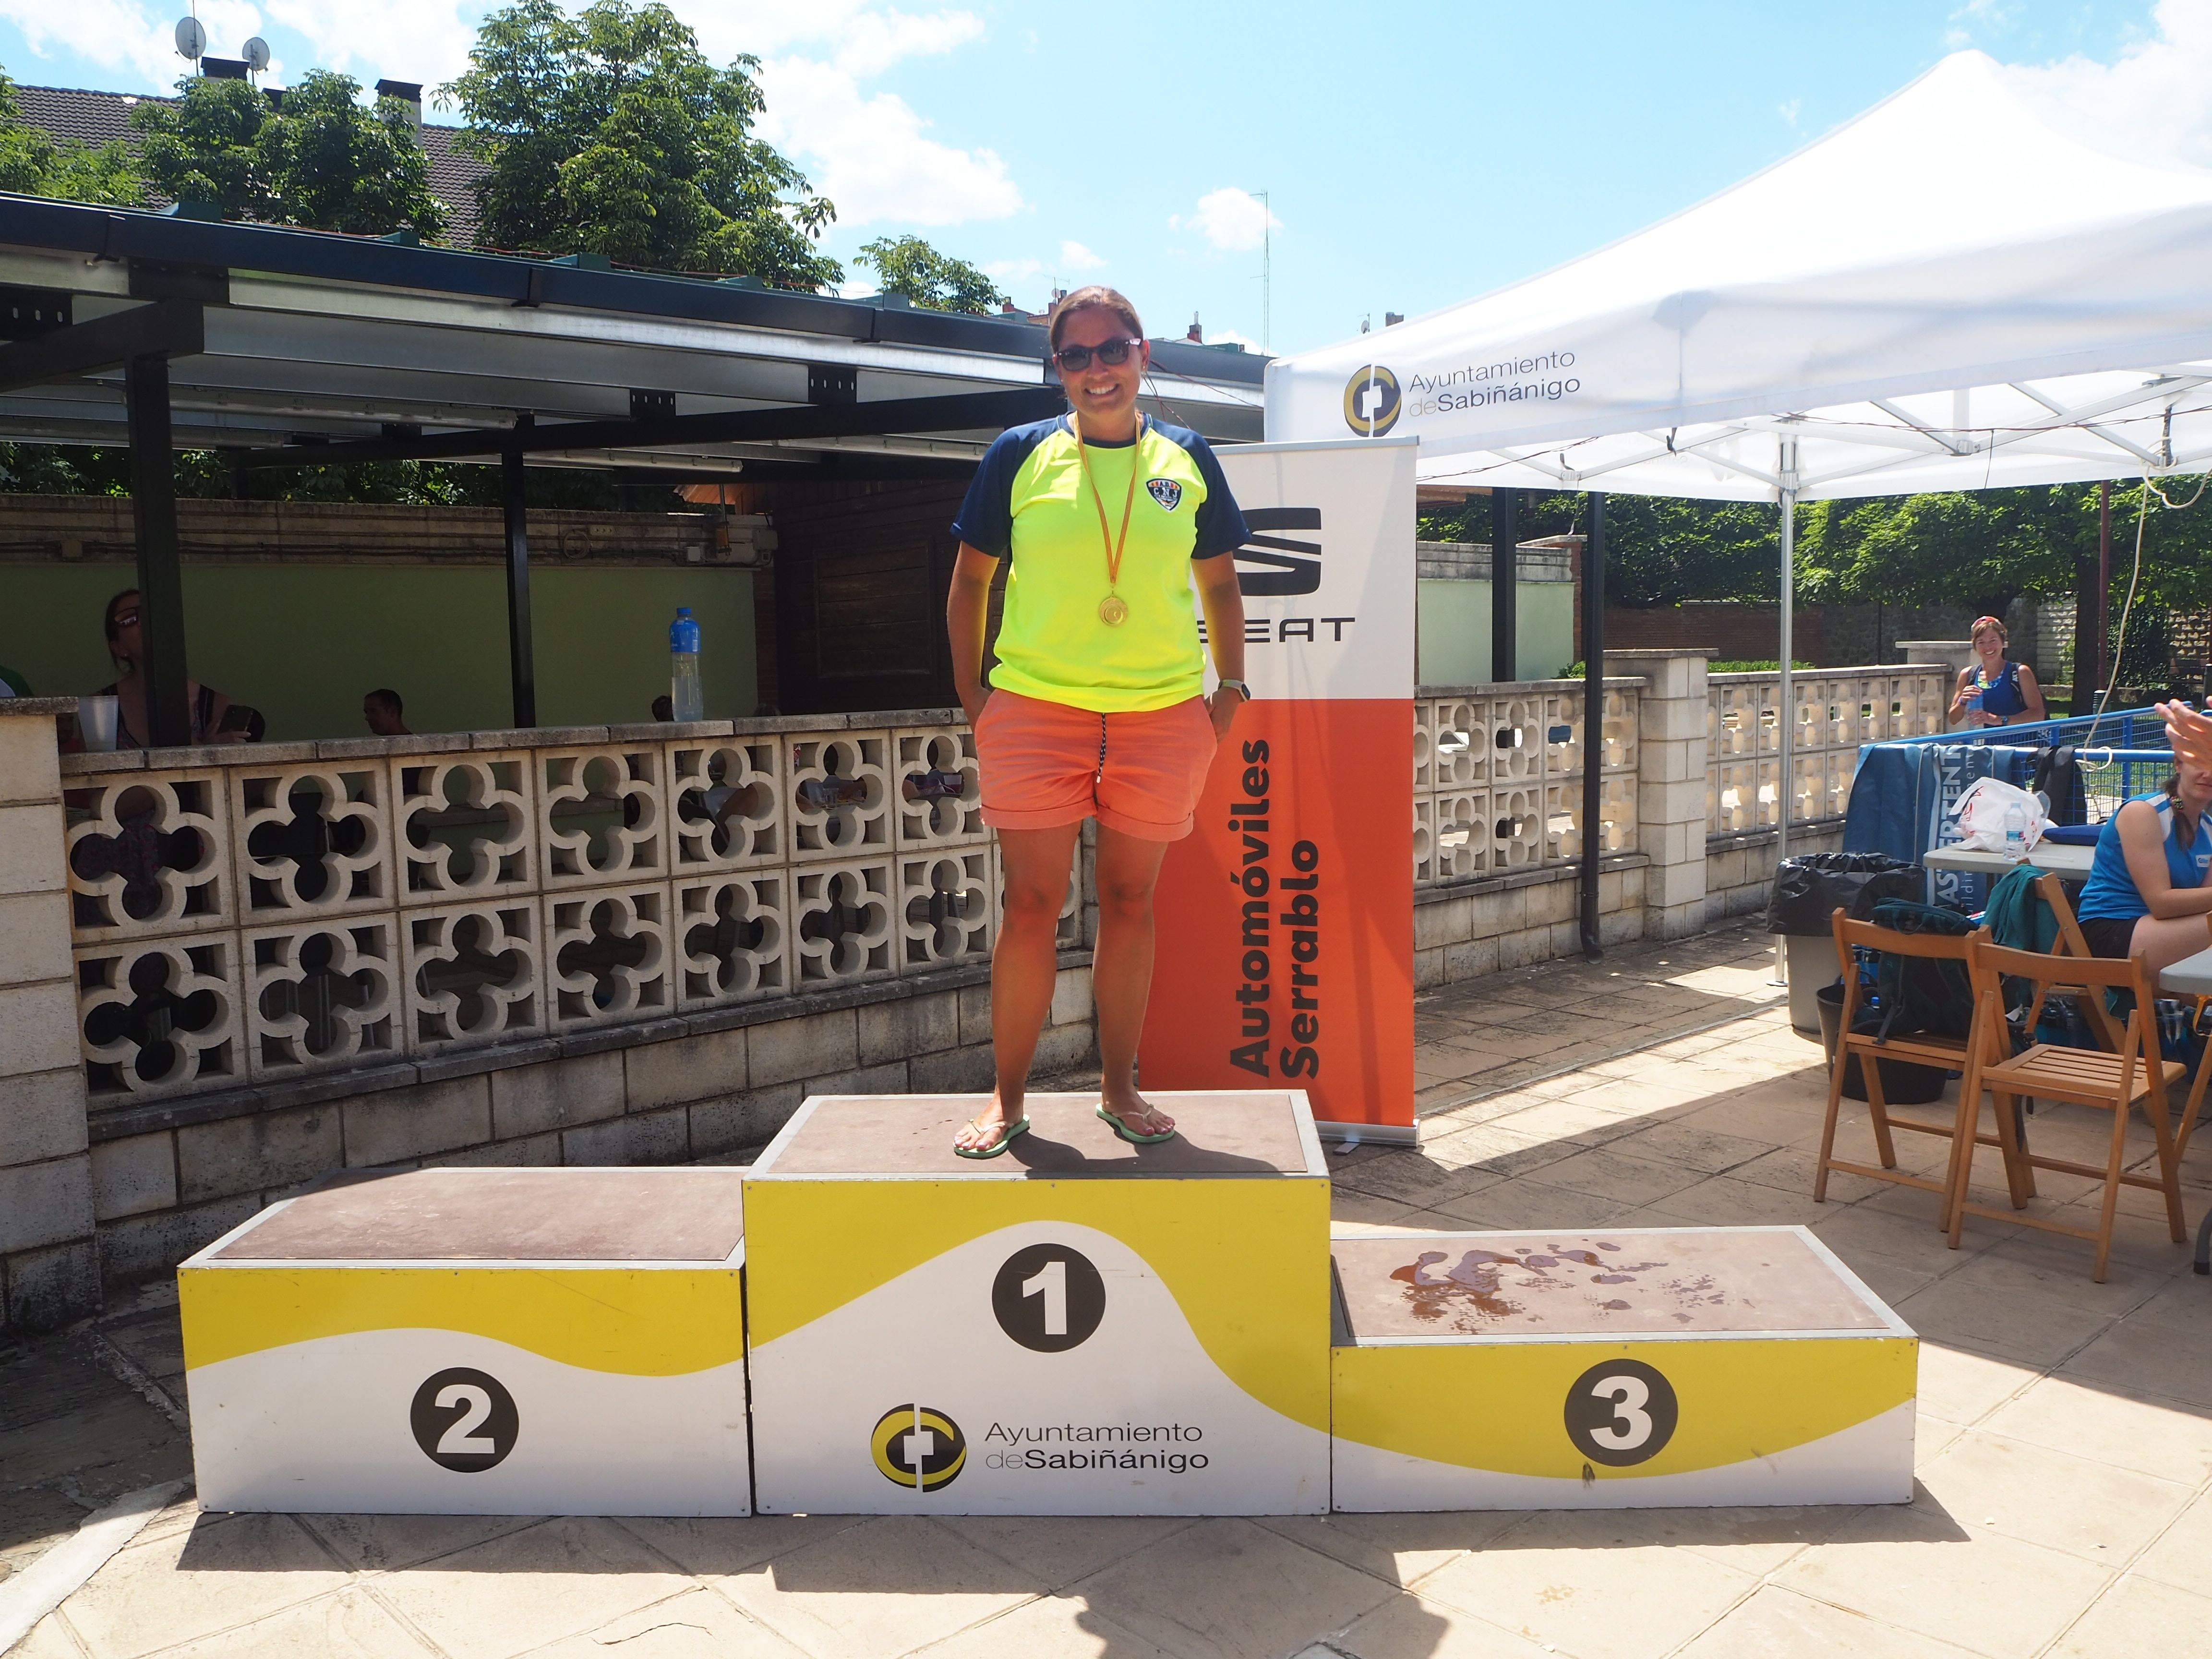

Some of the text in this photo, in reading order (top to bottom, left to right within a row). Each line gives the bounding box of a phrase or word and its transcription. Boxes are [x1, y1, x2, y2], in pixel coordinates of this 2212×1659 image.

[1409, 351, 1575, 394] Ayuntamiento
[1409, 378, 1581, 417] deSabiñánigo
[1227, 739, 1270, 1079] Automóviles
[1280, 840, 1320, 1080] Serrablo
[1022, 1261, 1067, 1335] 1
[434, 1383, 495, 1454] 2
[985, 1422, 1202, 1446] Ayuntamiento
[1589, 1375, 1653, 1450] 3
[986, 1449, 1209, 1474] deSabiñánigo
